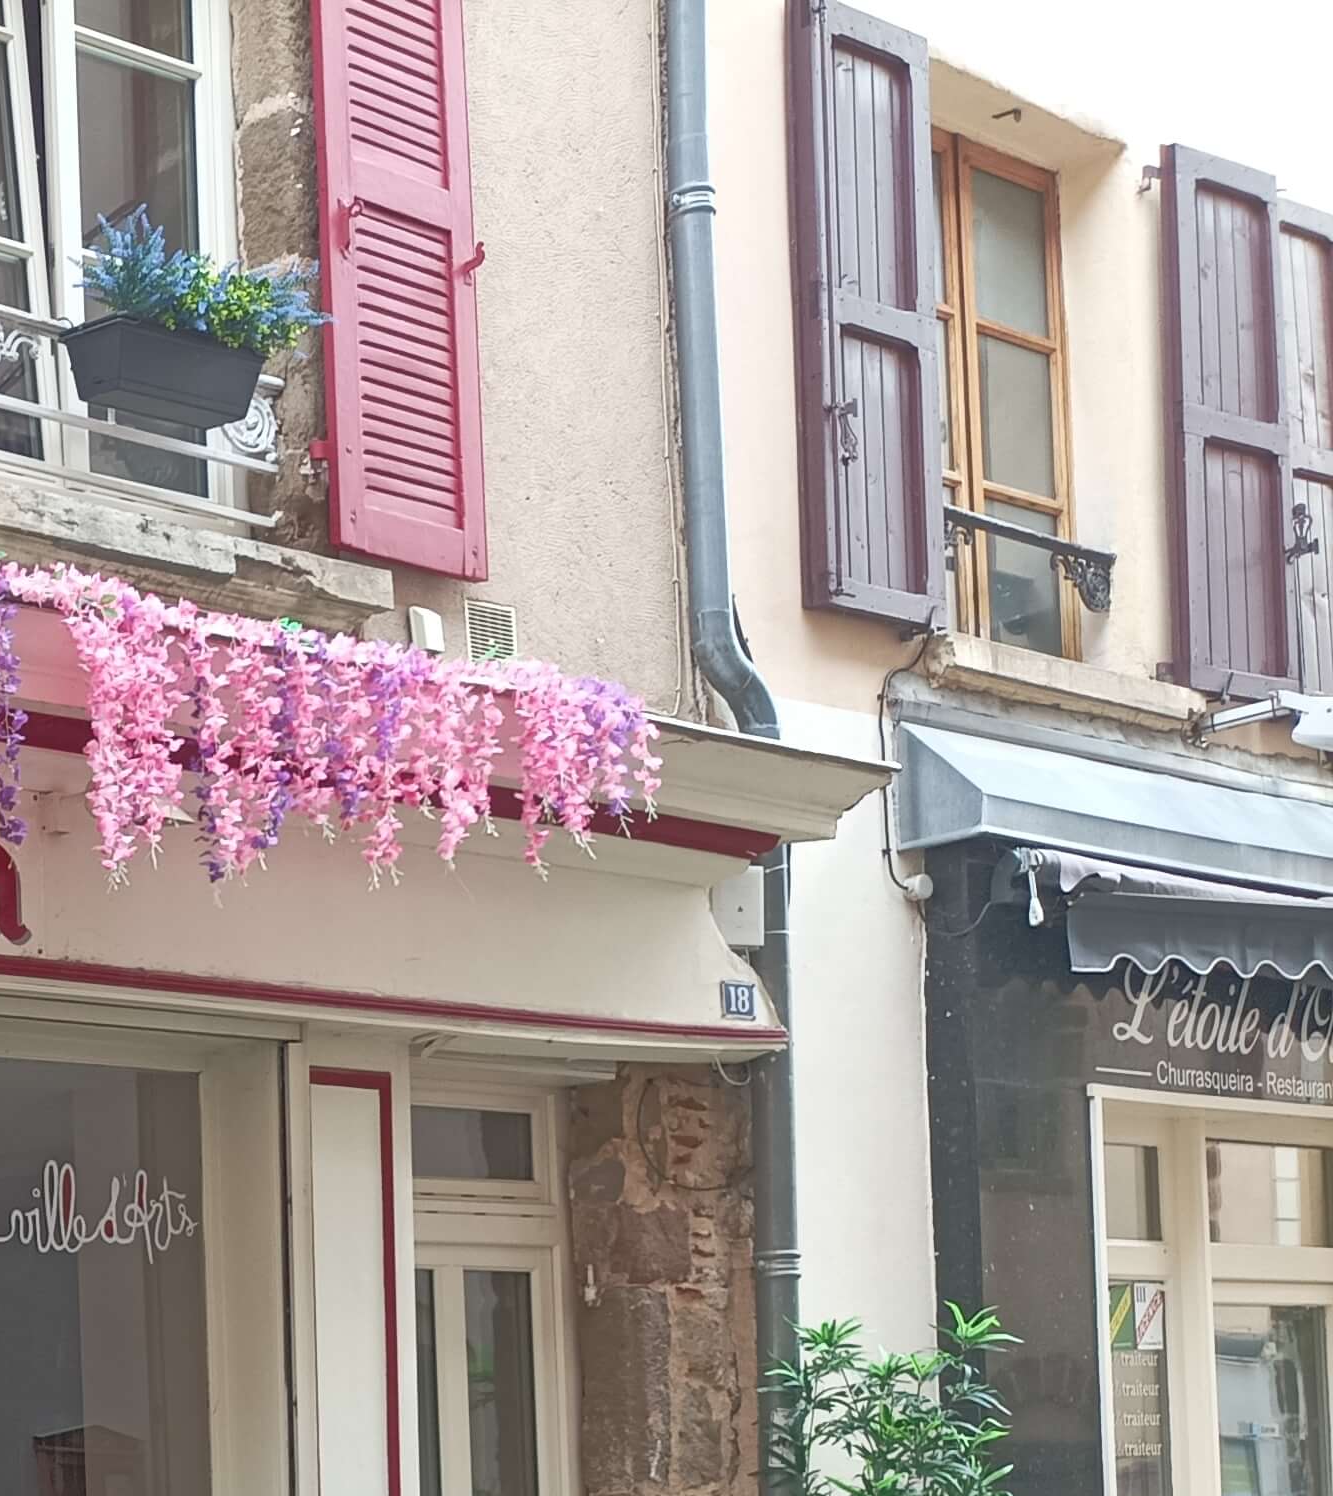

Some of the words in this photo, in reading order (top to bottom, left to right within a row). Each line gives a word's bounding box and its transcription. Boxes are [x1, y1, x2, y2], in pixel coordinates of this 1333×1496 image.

[728, 986, 750, 1013] 18
[1267, 977, 1333, 1064] d'O
[1156, 1060, 1254, 1093] Churrasqueira
[1266, 1071, 1333, 1099] Restauran
[10, 1159, 85, 1253] ville
[1121, 1352, 1158, 1367] traiteur
[1122, 1381, 1160, 1396] traiteur
[1124, 1410, 1161, 1426] traiteur
[1125, 1440, 1163, 1457] traiteur
